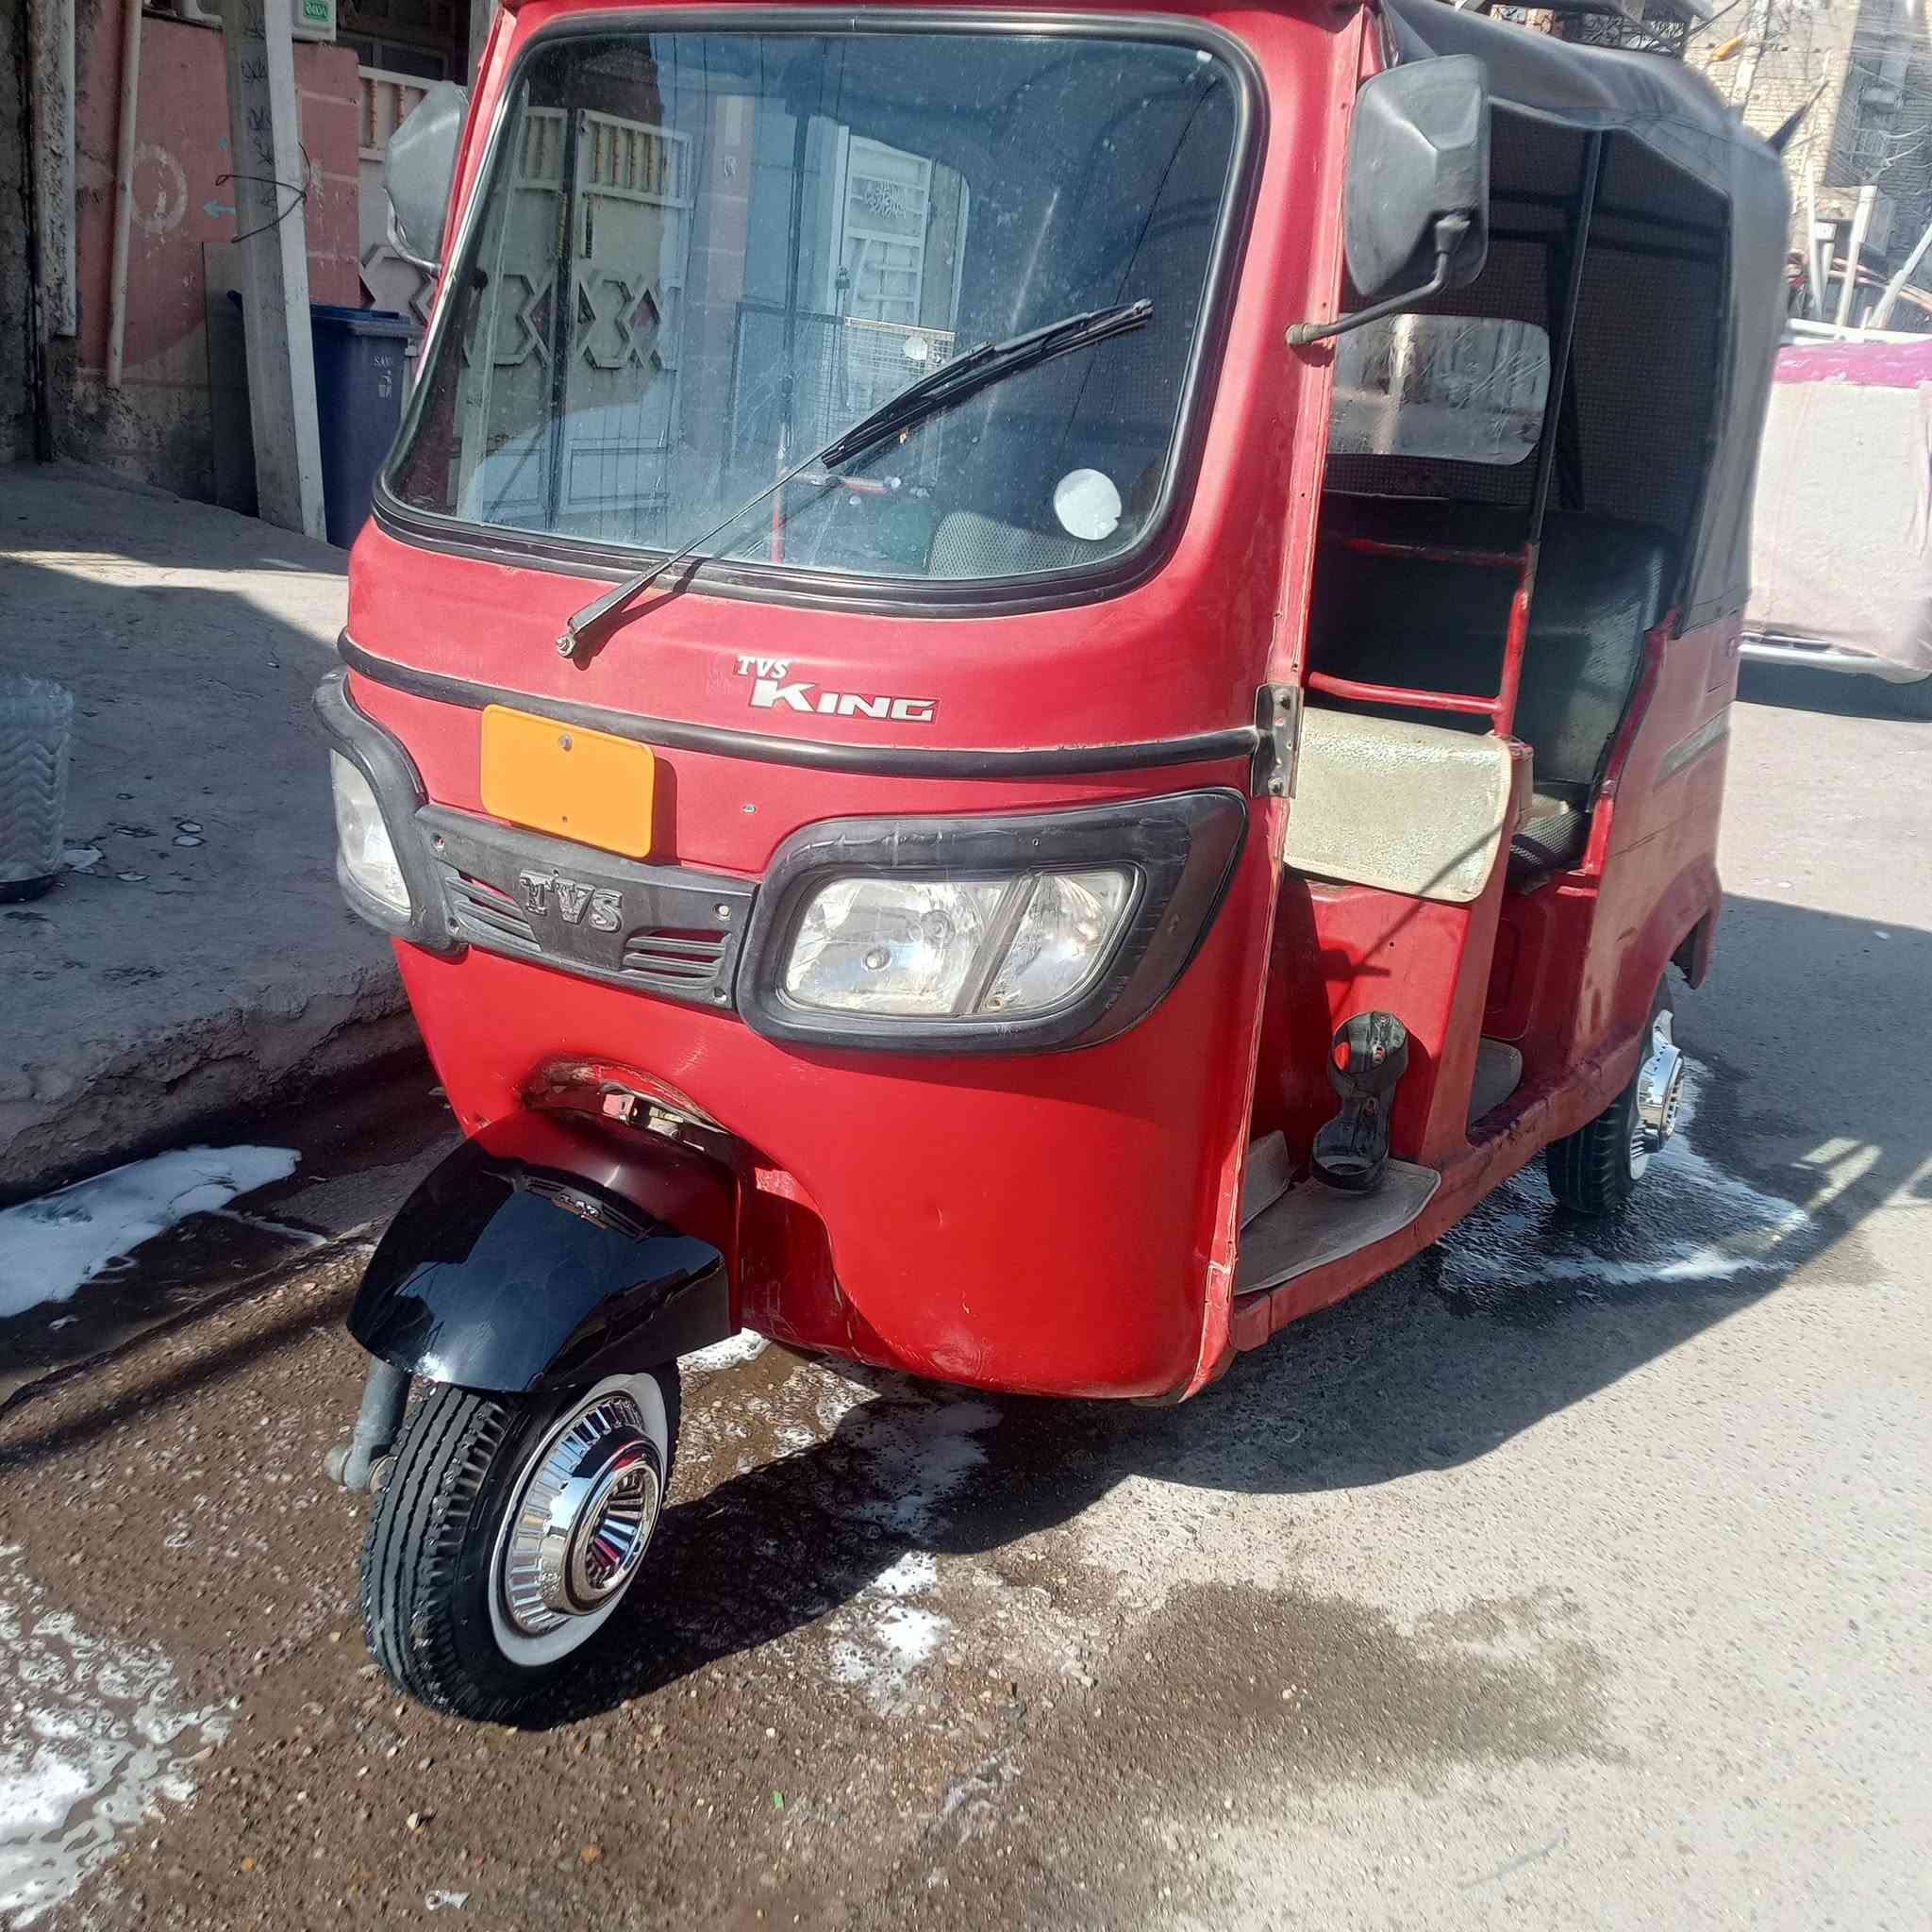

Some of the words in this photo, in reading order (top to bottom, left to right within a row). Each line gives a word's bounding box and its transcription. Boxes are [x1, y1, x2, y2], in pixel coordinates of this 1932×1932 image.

[737, 655, 791, 679] TVS
[750, 678, 937, 723] KING
[519, 869, 623, 933] TVS
